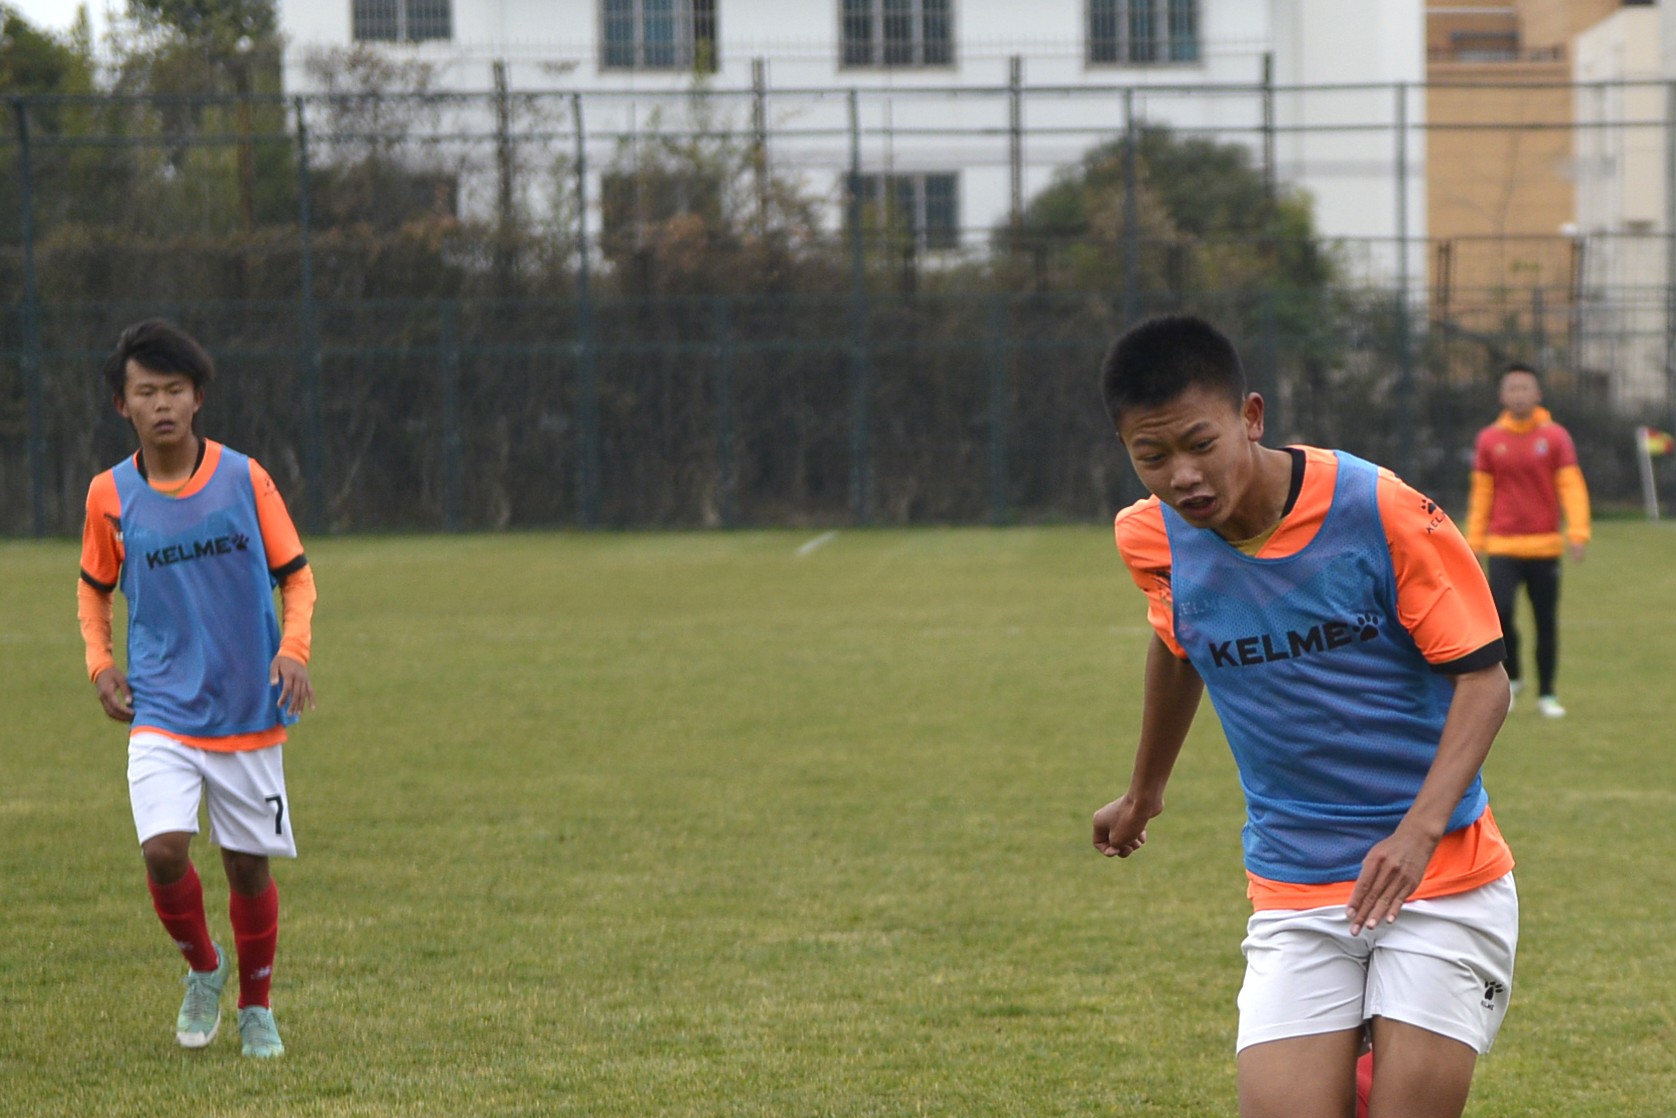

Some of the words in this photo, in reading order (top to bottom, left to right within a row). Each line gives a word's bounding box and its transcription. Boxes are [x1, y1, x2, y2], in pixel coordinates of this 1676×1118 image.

[145, 536, 231, 570] KELME
[1208, 621, 1353, 669] KELME
[265, 795, 284, 835] 7
